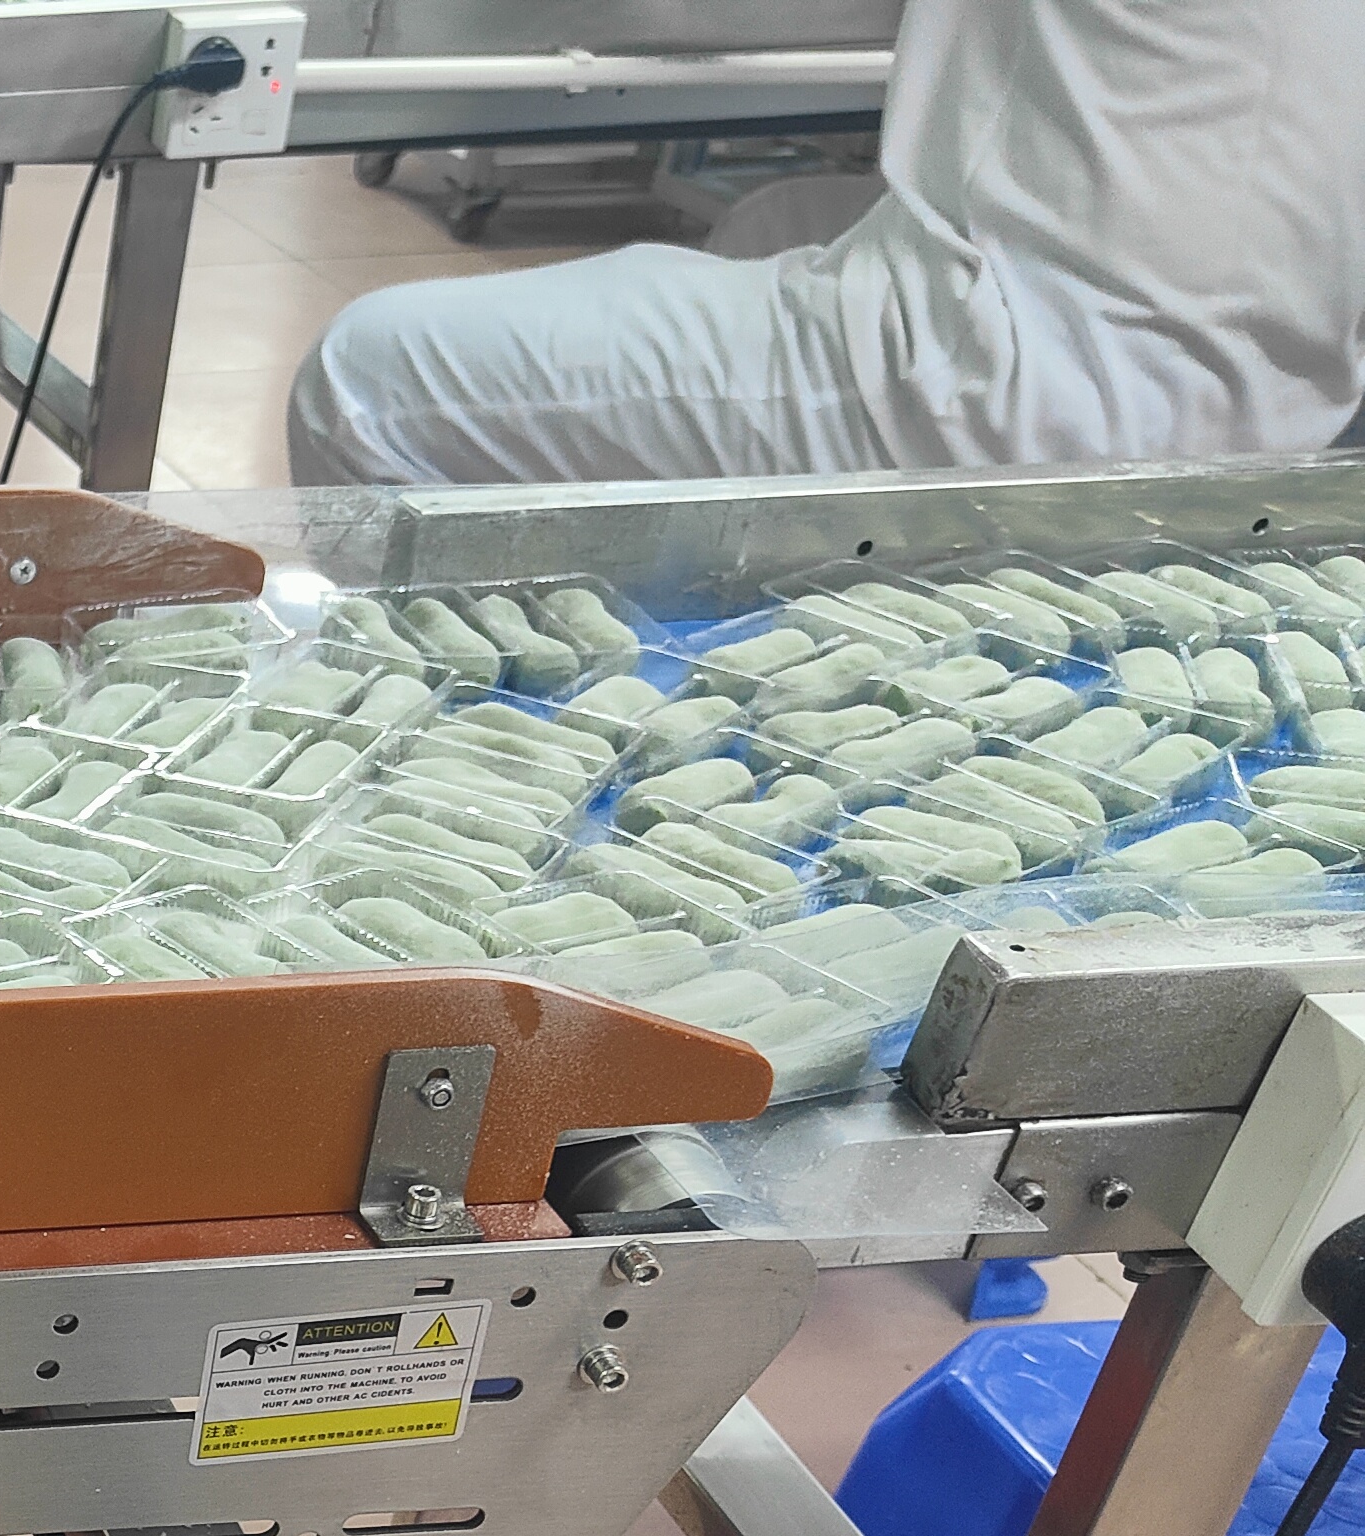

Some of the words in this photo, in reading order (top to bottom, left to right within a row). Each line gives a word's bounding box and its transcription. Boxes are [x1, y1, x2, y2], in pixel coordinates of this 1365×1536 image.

[302, 1320, 395, 1341] ATTENTION
[333, 1347, 360, 1356] Please
[362, 1344, 392, 1353] caution
[267, 1372, 297, 1384] WHEN
[449, 1358, 465, 1367] OR
[263, 1387, 297, 1397] CLOTH
[299, 1384, 324, 1394] INTO
[328, 1382, 347, 1391] THE
[400, 1375, 413, 1384] TO
[417, 1373, 447, 1383] AVOID
[261, 1400, 288, 1409] HURT
[291, 1397, 313, 1406] AND
[316, 1394, 350, 1404] OTHER
